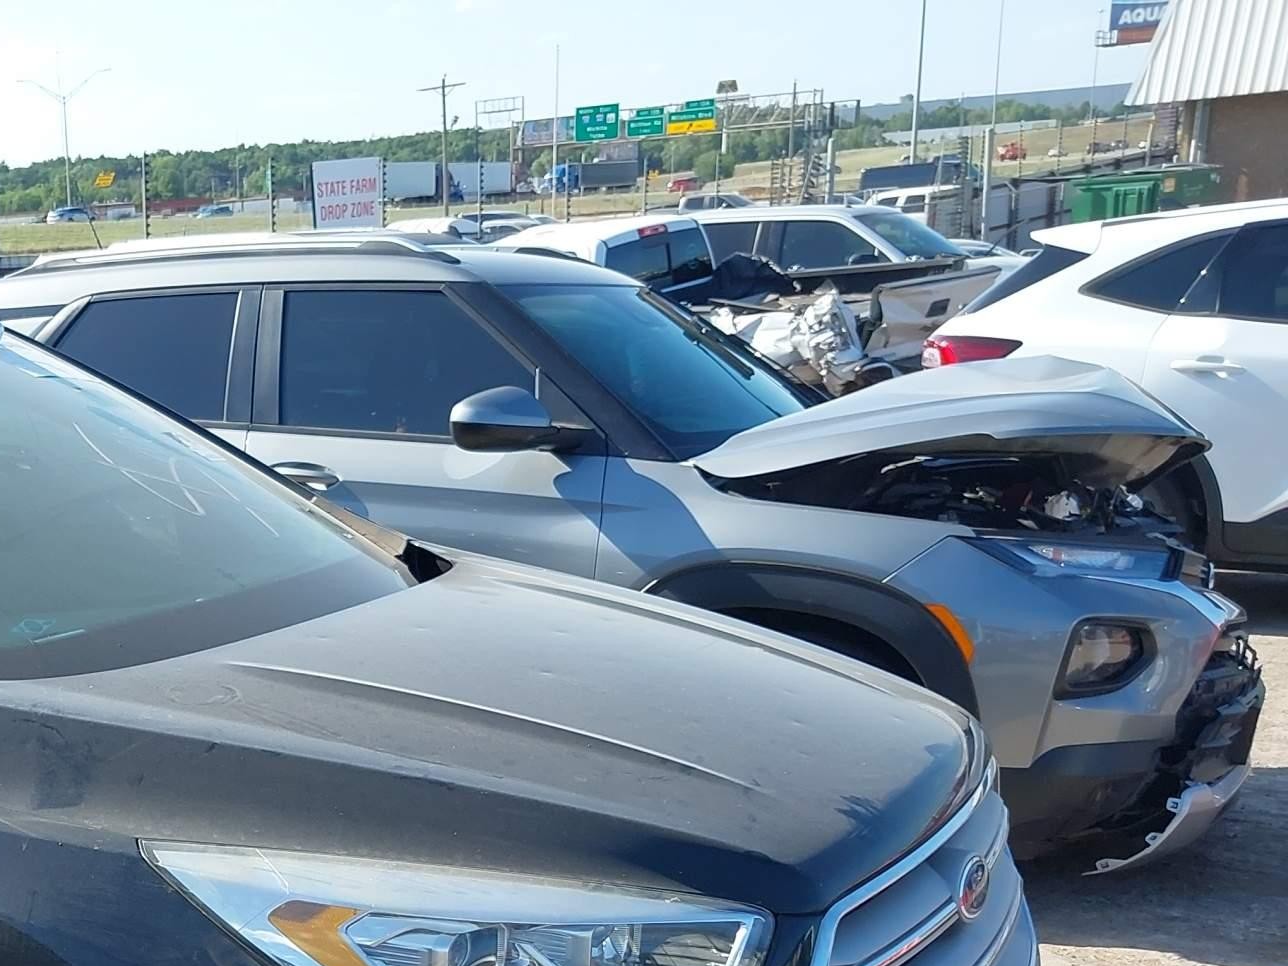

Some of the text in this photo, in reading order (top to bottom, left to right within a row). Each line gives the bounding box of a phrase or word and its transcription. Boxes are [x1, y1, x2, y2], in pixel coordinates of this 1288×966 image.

[316, 177, 377, 198] STATE FARM
[320, 200, 375, 221] DROP ZONE
